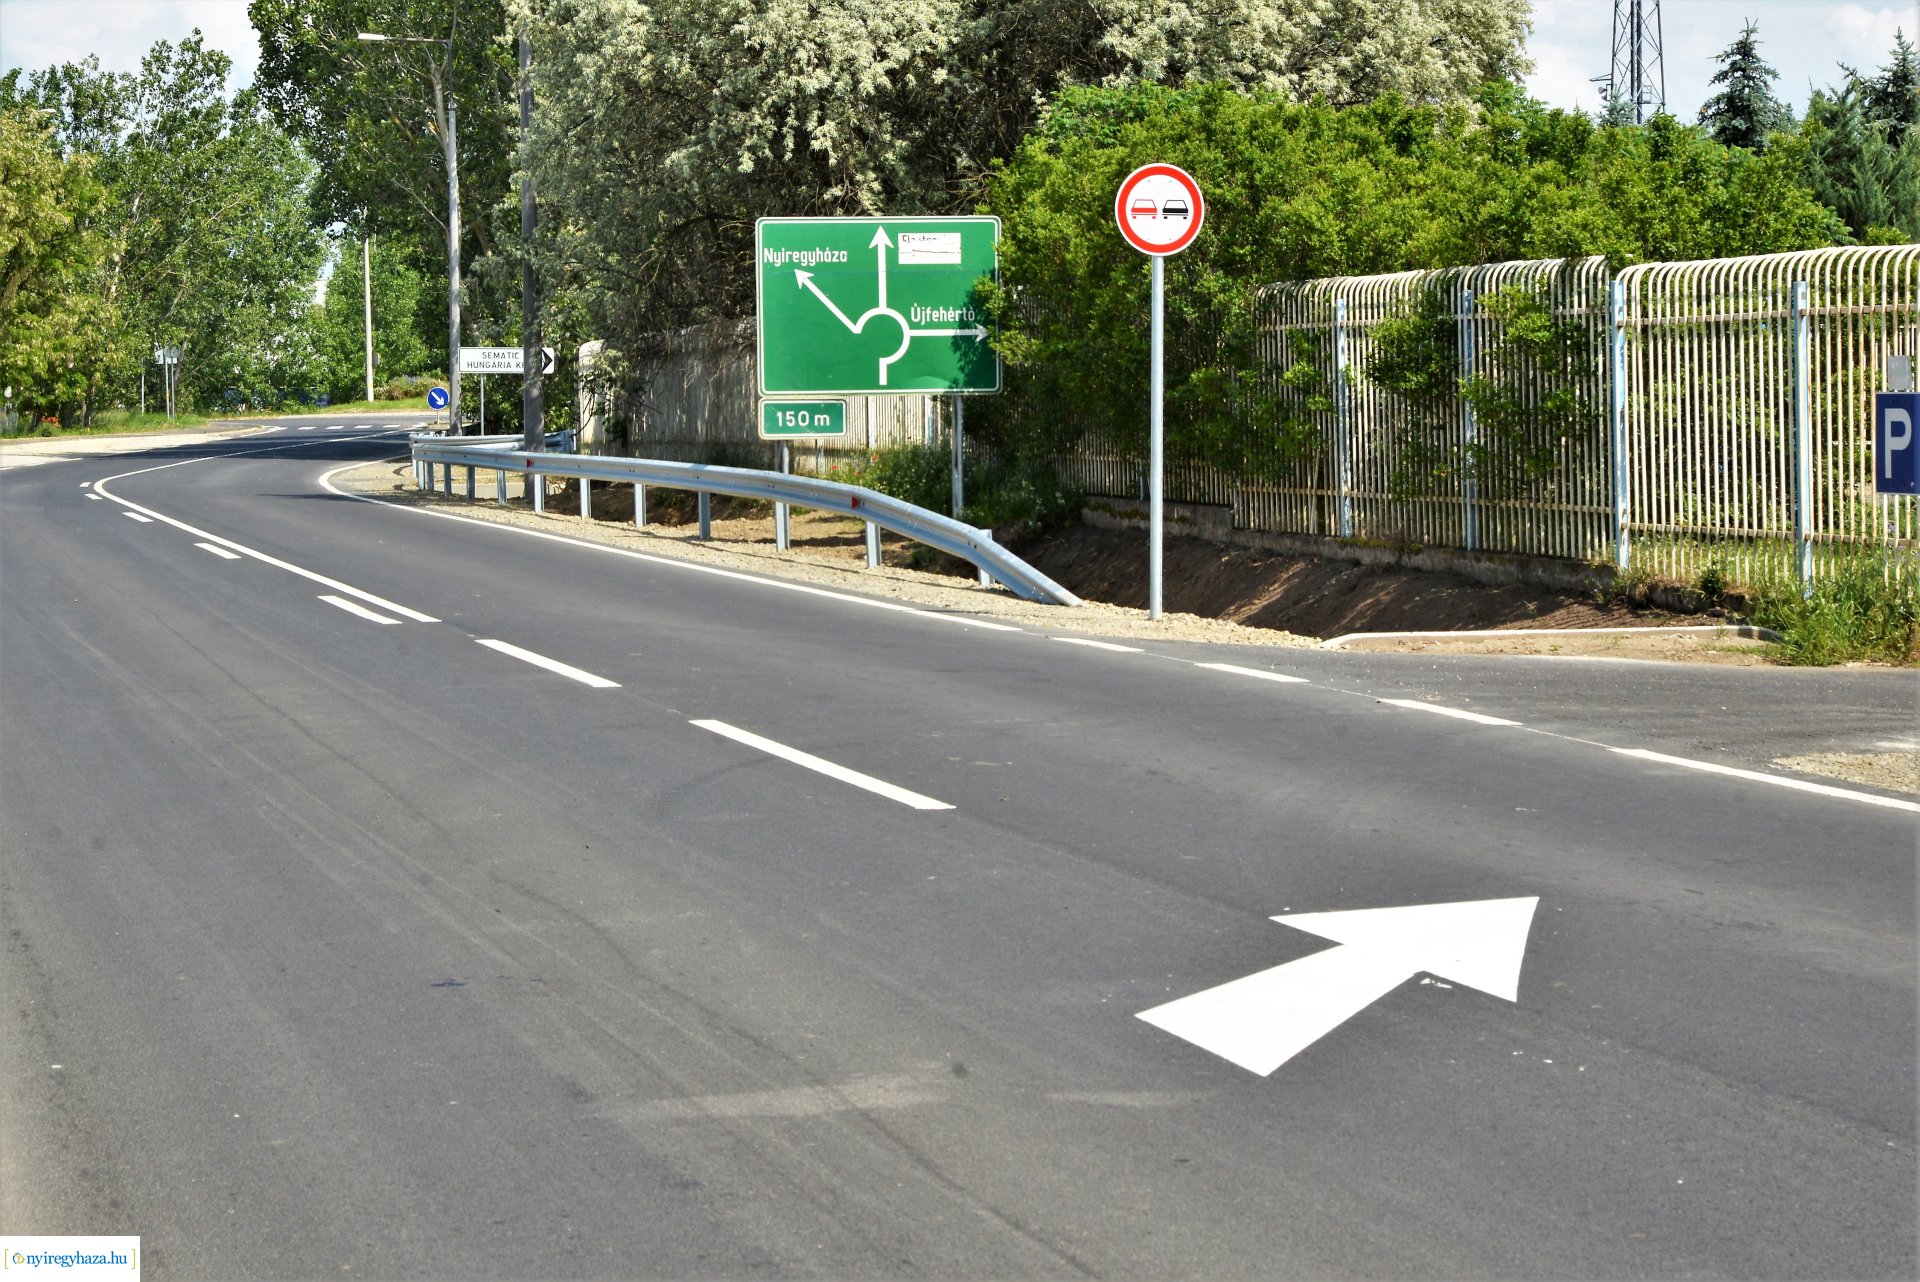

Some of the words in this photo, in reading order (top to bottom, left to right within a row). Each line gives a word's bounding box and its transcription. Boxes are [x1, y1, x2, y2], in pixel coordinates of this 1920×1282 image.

[910, 302, 976, 326] Újfehértó
[481, 351, 520, 360] SEMATIC
[776, 410, 810, 427] 150
[814, 413, 830, 426] m
[1884, 407, 1912, 479] P
